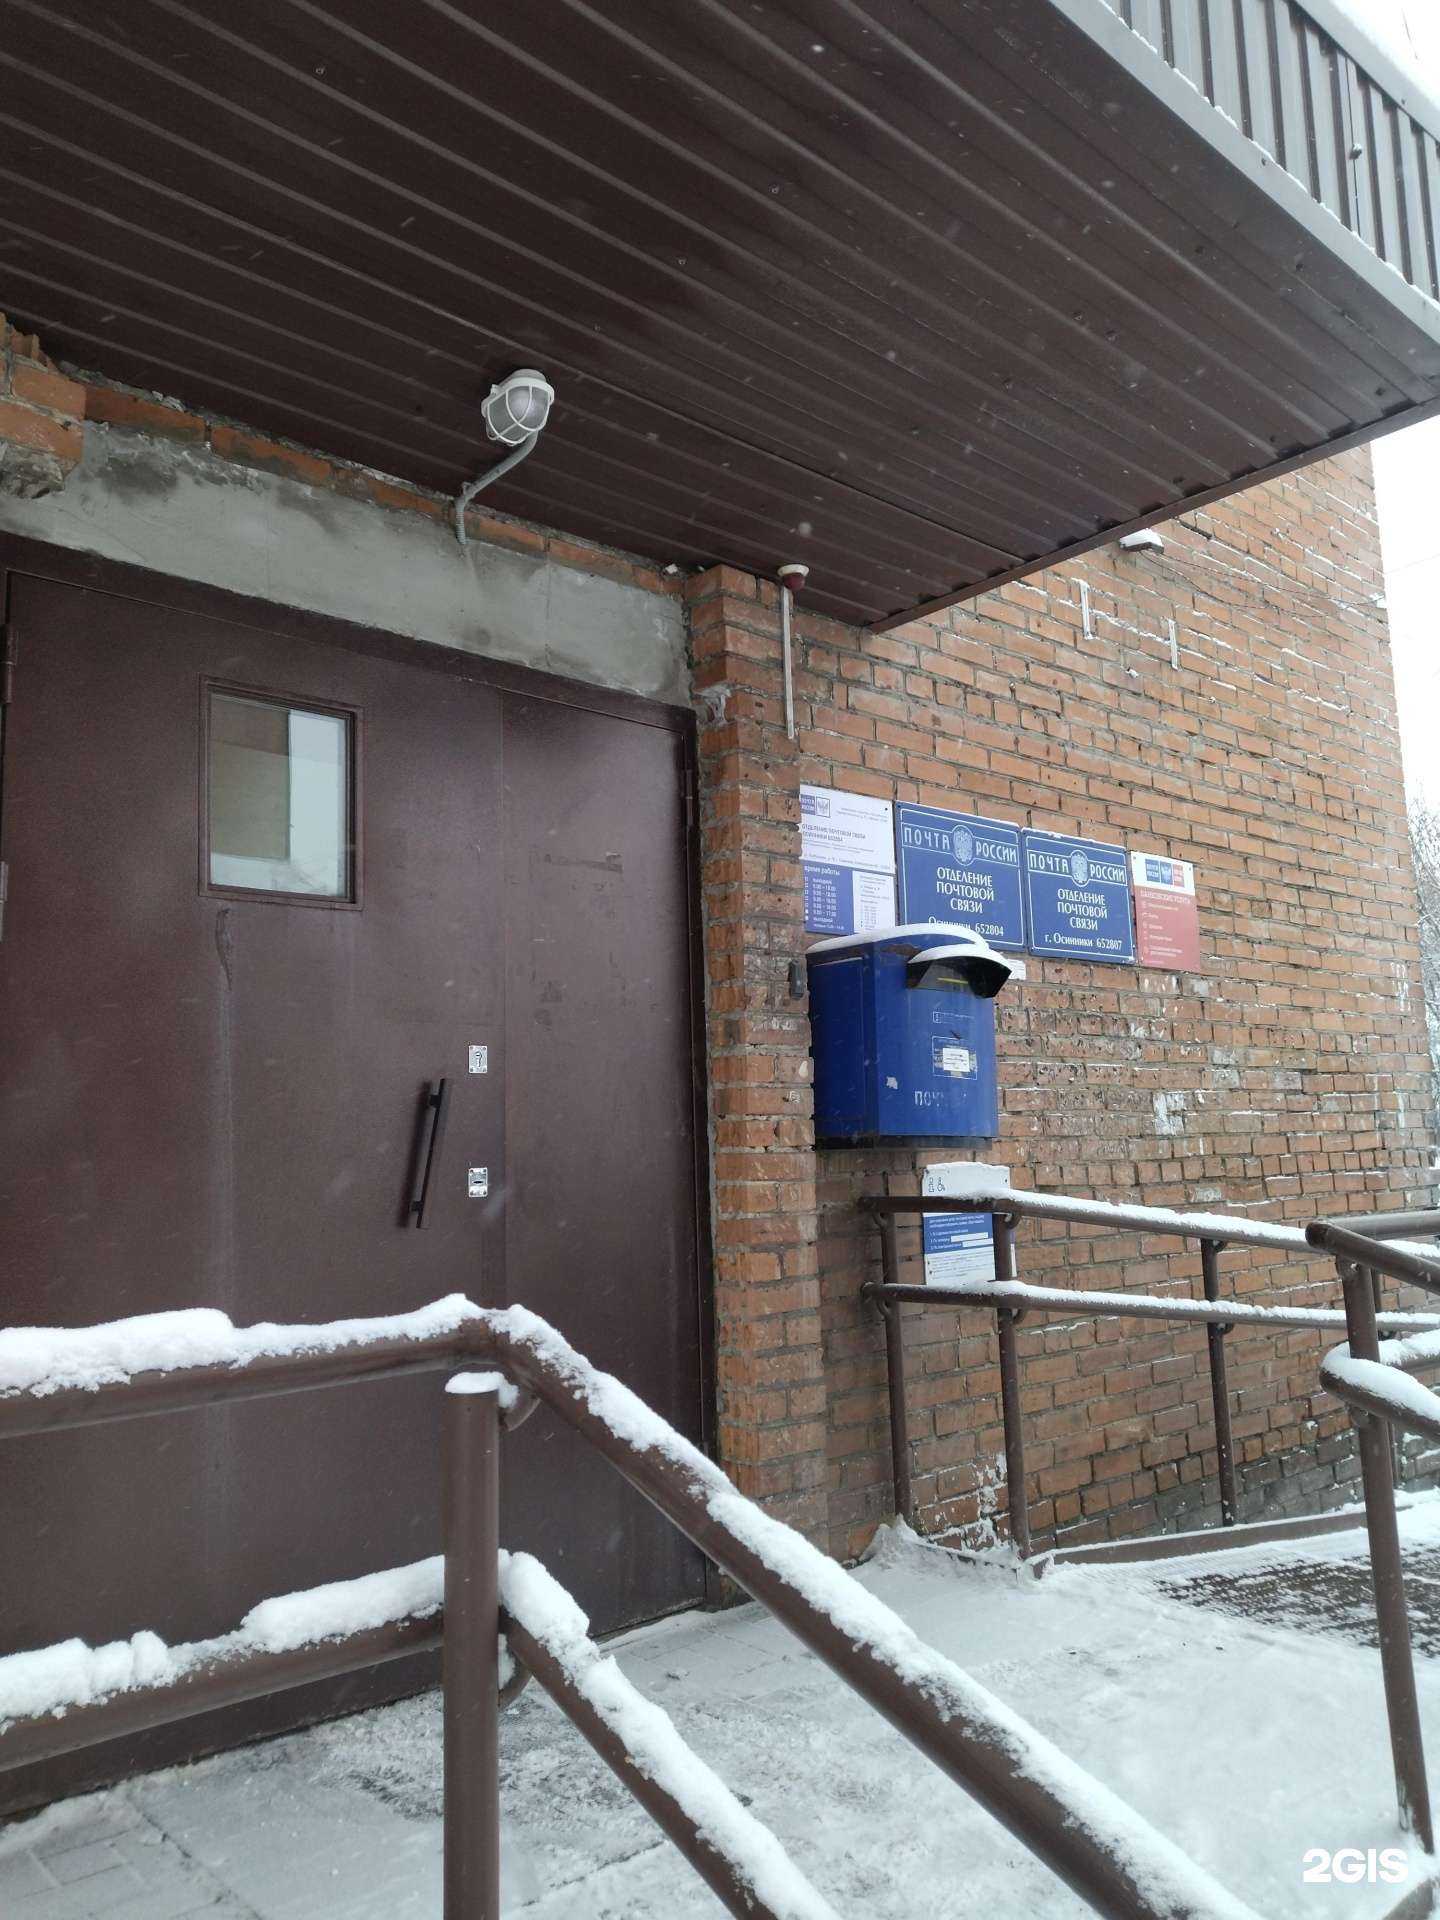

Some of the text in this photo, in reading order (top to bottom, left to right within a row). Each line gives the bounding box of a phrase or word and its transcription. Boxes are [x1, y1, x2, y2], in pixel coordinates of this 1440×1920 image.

[904, 827, 1017, 862] ПОЧТА РОССИИ
[1030, 853, 1069, 873] ПОЧТА
[1090, 864, 1125, 882] РОССИИ
[937, 866, 993, 887] ОТДЕЛЕНИЕ
[936, 882, 994, 901] ПОЧТОВОЙ
[1057, 888, 1106, 905] ОТДЕЛЕНИЕ
[950, 898, 983, 914] СВЯЗИ
[1057, 902, 1107, 918] ПОЧТОВОЙ
[1069, 917, 1098, 931] СВЯЗИ
[1053, 932, 1093, 947] Осинники
